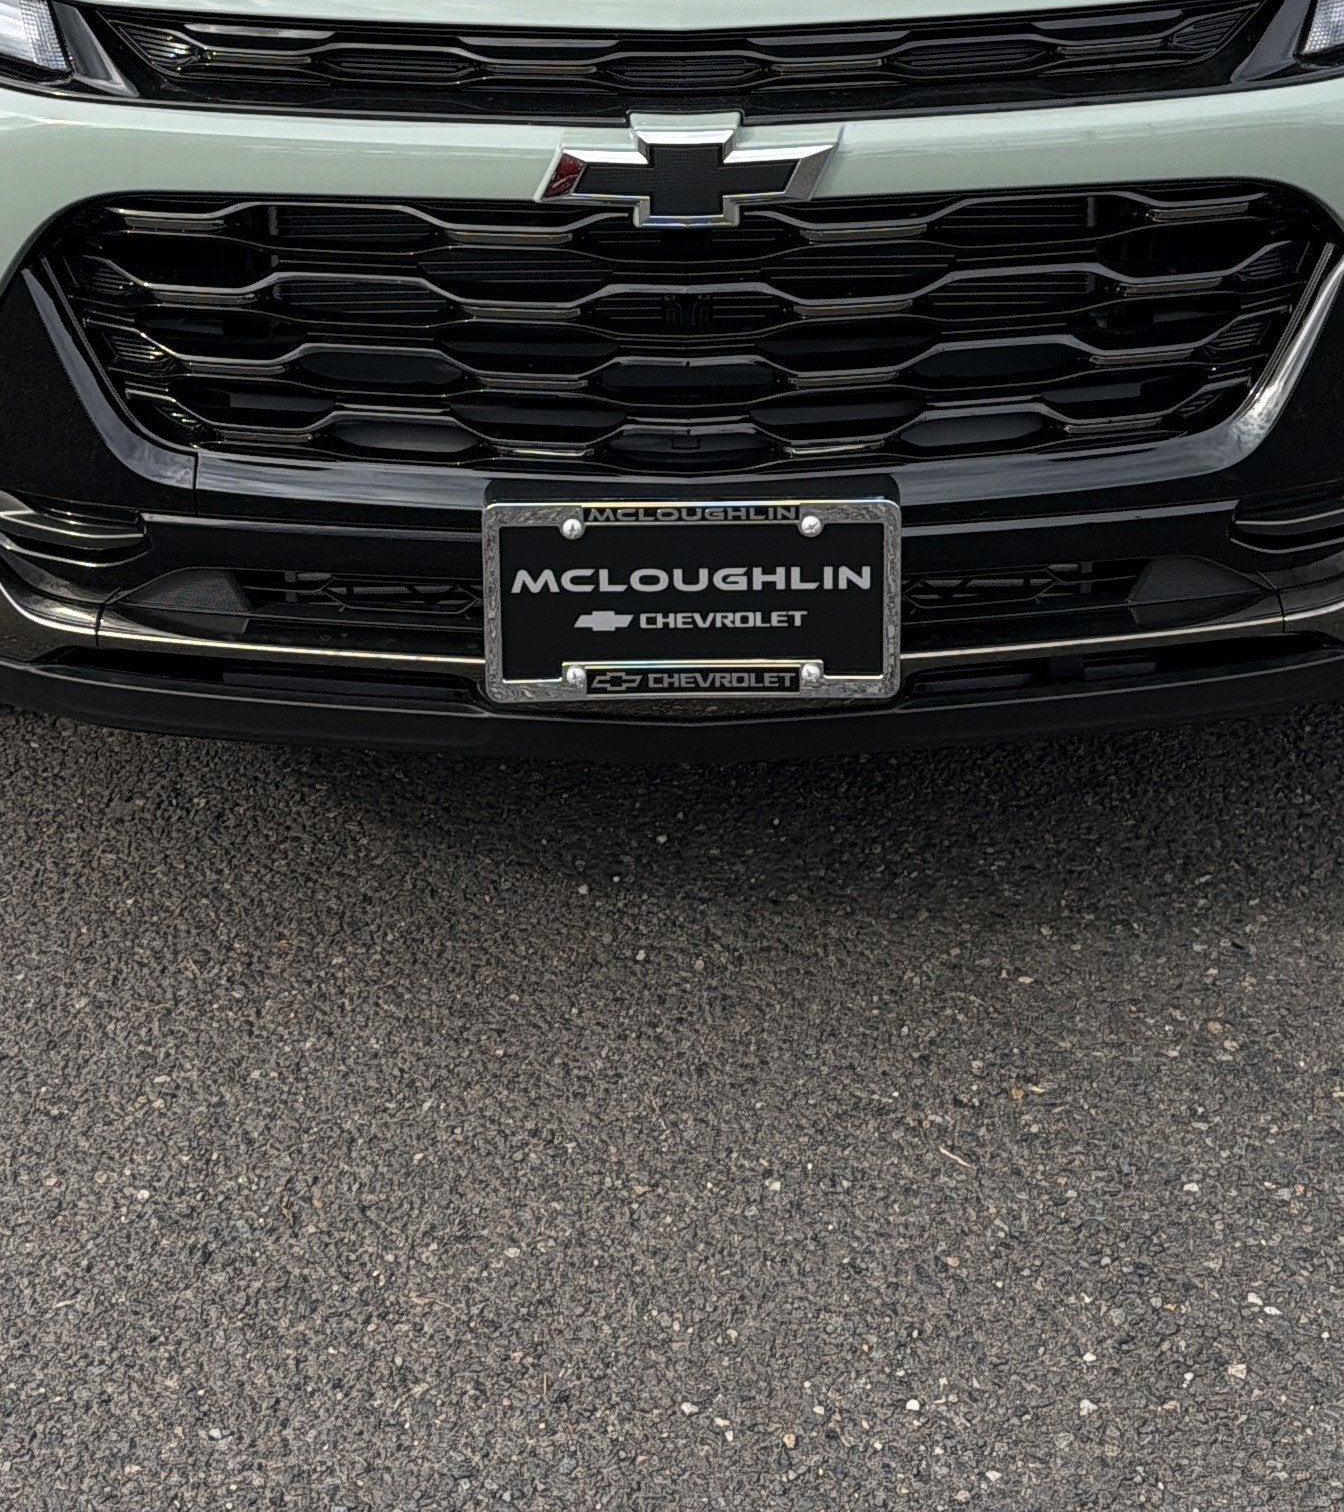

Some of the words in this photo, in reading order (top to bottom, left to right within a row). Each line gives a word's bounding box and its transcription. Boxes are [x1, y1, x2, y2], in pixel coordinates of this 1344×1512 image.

[587, 505, 798, 522] MCLOUGHLIN
[510, 565, 871, 594] MCLOUGHLIN
[638, 609, 808, 630] CHEVROLET
[646, 671, 797, 688] CHEVROLET
